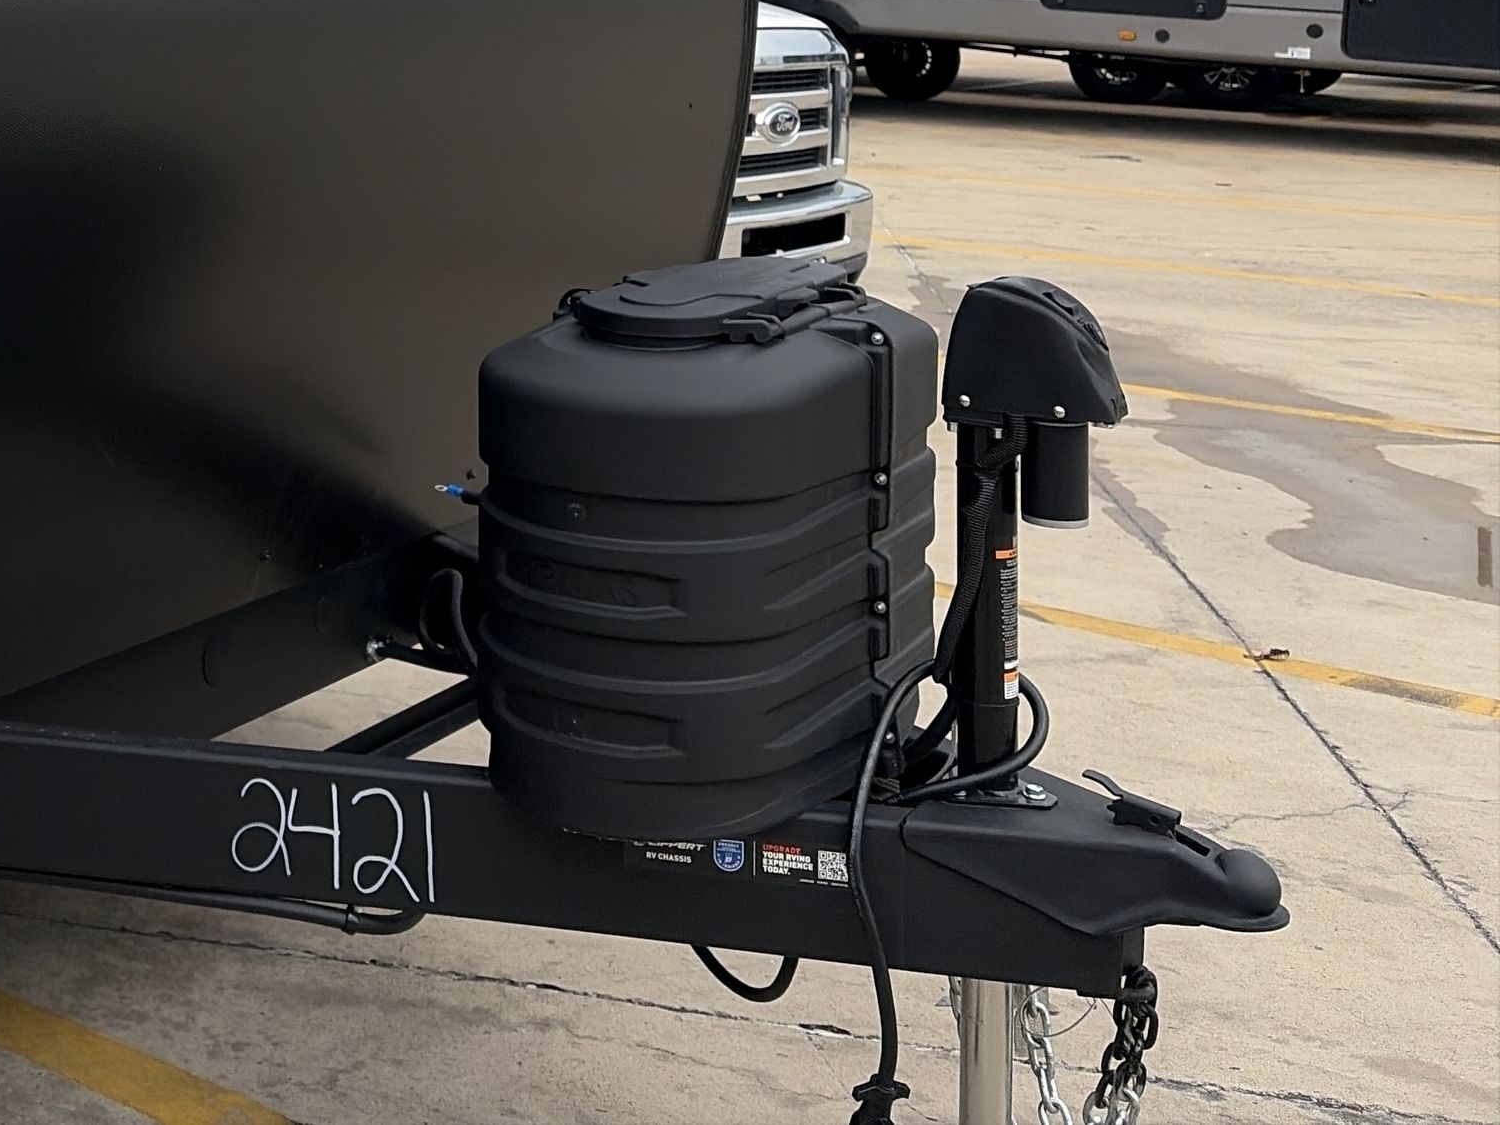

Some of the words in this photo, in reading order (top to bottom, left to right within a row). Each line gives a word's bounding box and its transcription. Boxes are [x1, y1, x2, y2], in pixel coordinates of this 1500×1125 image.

[231, 778, 435, 903] 2421
[762, 843, 802, 855] UPGRADE
[646, 851, 656, 859] RV
[658, 853, 692, 864] CHASSIS
[762, 851, 784, 860] YOUR
[762, 858, 814, 871] EXPERIENCE
[762, 865, 791, 876] TODAY.
